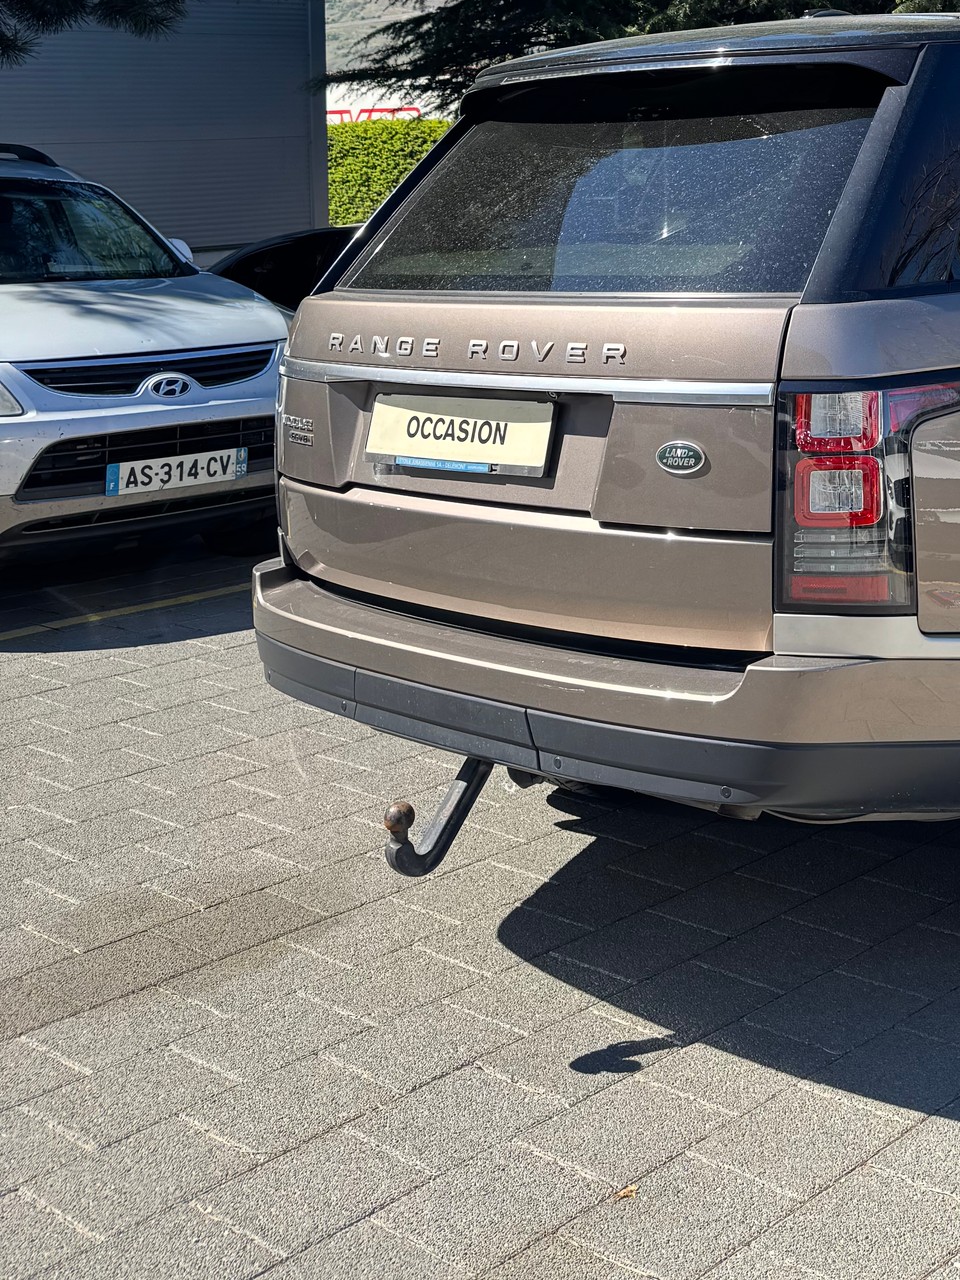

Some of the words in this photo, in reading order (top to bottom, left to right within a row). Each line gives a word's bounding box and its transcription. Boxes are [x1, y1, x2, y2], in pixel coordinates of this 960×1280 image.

[328, 332, 440, 357] RANGE
[467, 339, 627, 365] ROVER
[406, 415, 508, 445] OCCASION
[665, 448, 688, 457] LAND
[667, 457, 695, 466] ROVER
[109, 482, 115, 490] F
[125, 454, 231, 489] AS-314-CV
[236, 463, 247, 475] 59
